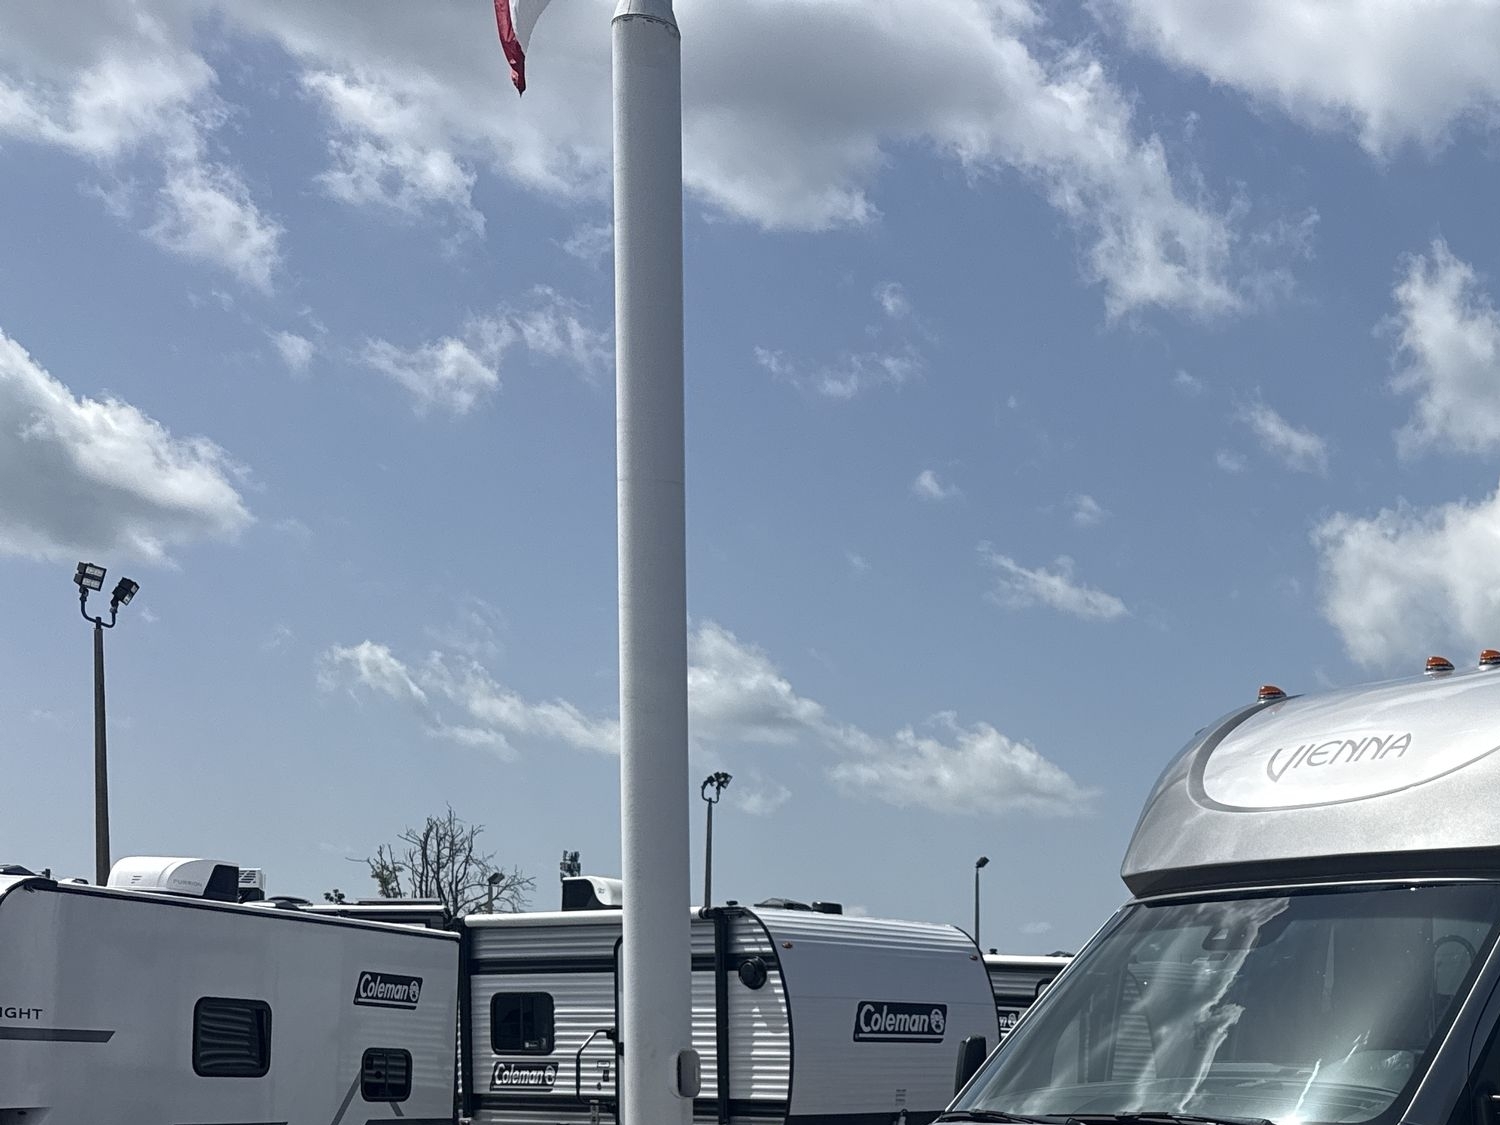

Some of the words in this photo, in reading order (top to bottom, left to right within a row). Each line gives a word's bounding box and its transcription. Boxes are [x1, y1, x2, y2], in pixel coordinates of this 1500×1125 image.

[1266, 732, 1412, 783] VIENNA
[360, 973, 409, 1000] Coleman
[860, 1004, 930, 1033] Coleman
[494, 1063, 544, 1085] Coleman
